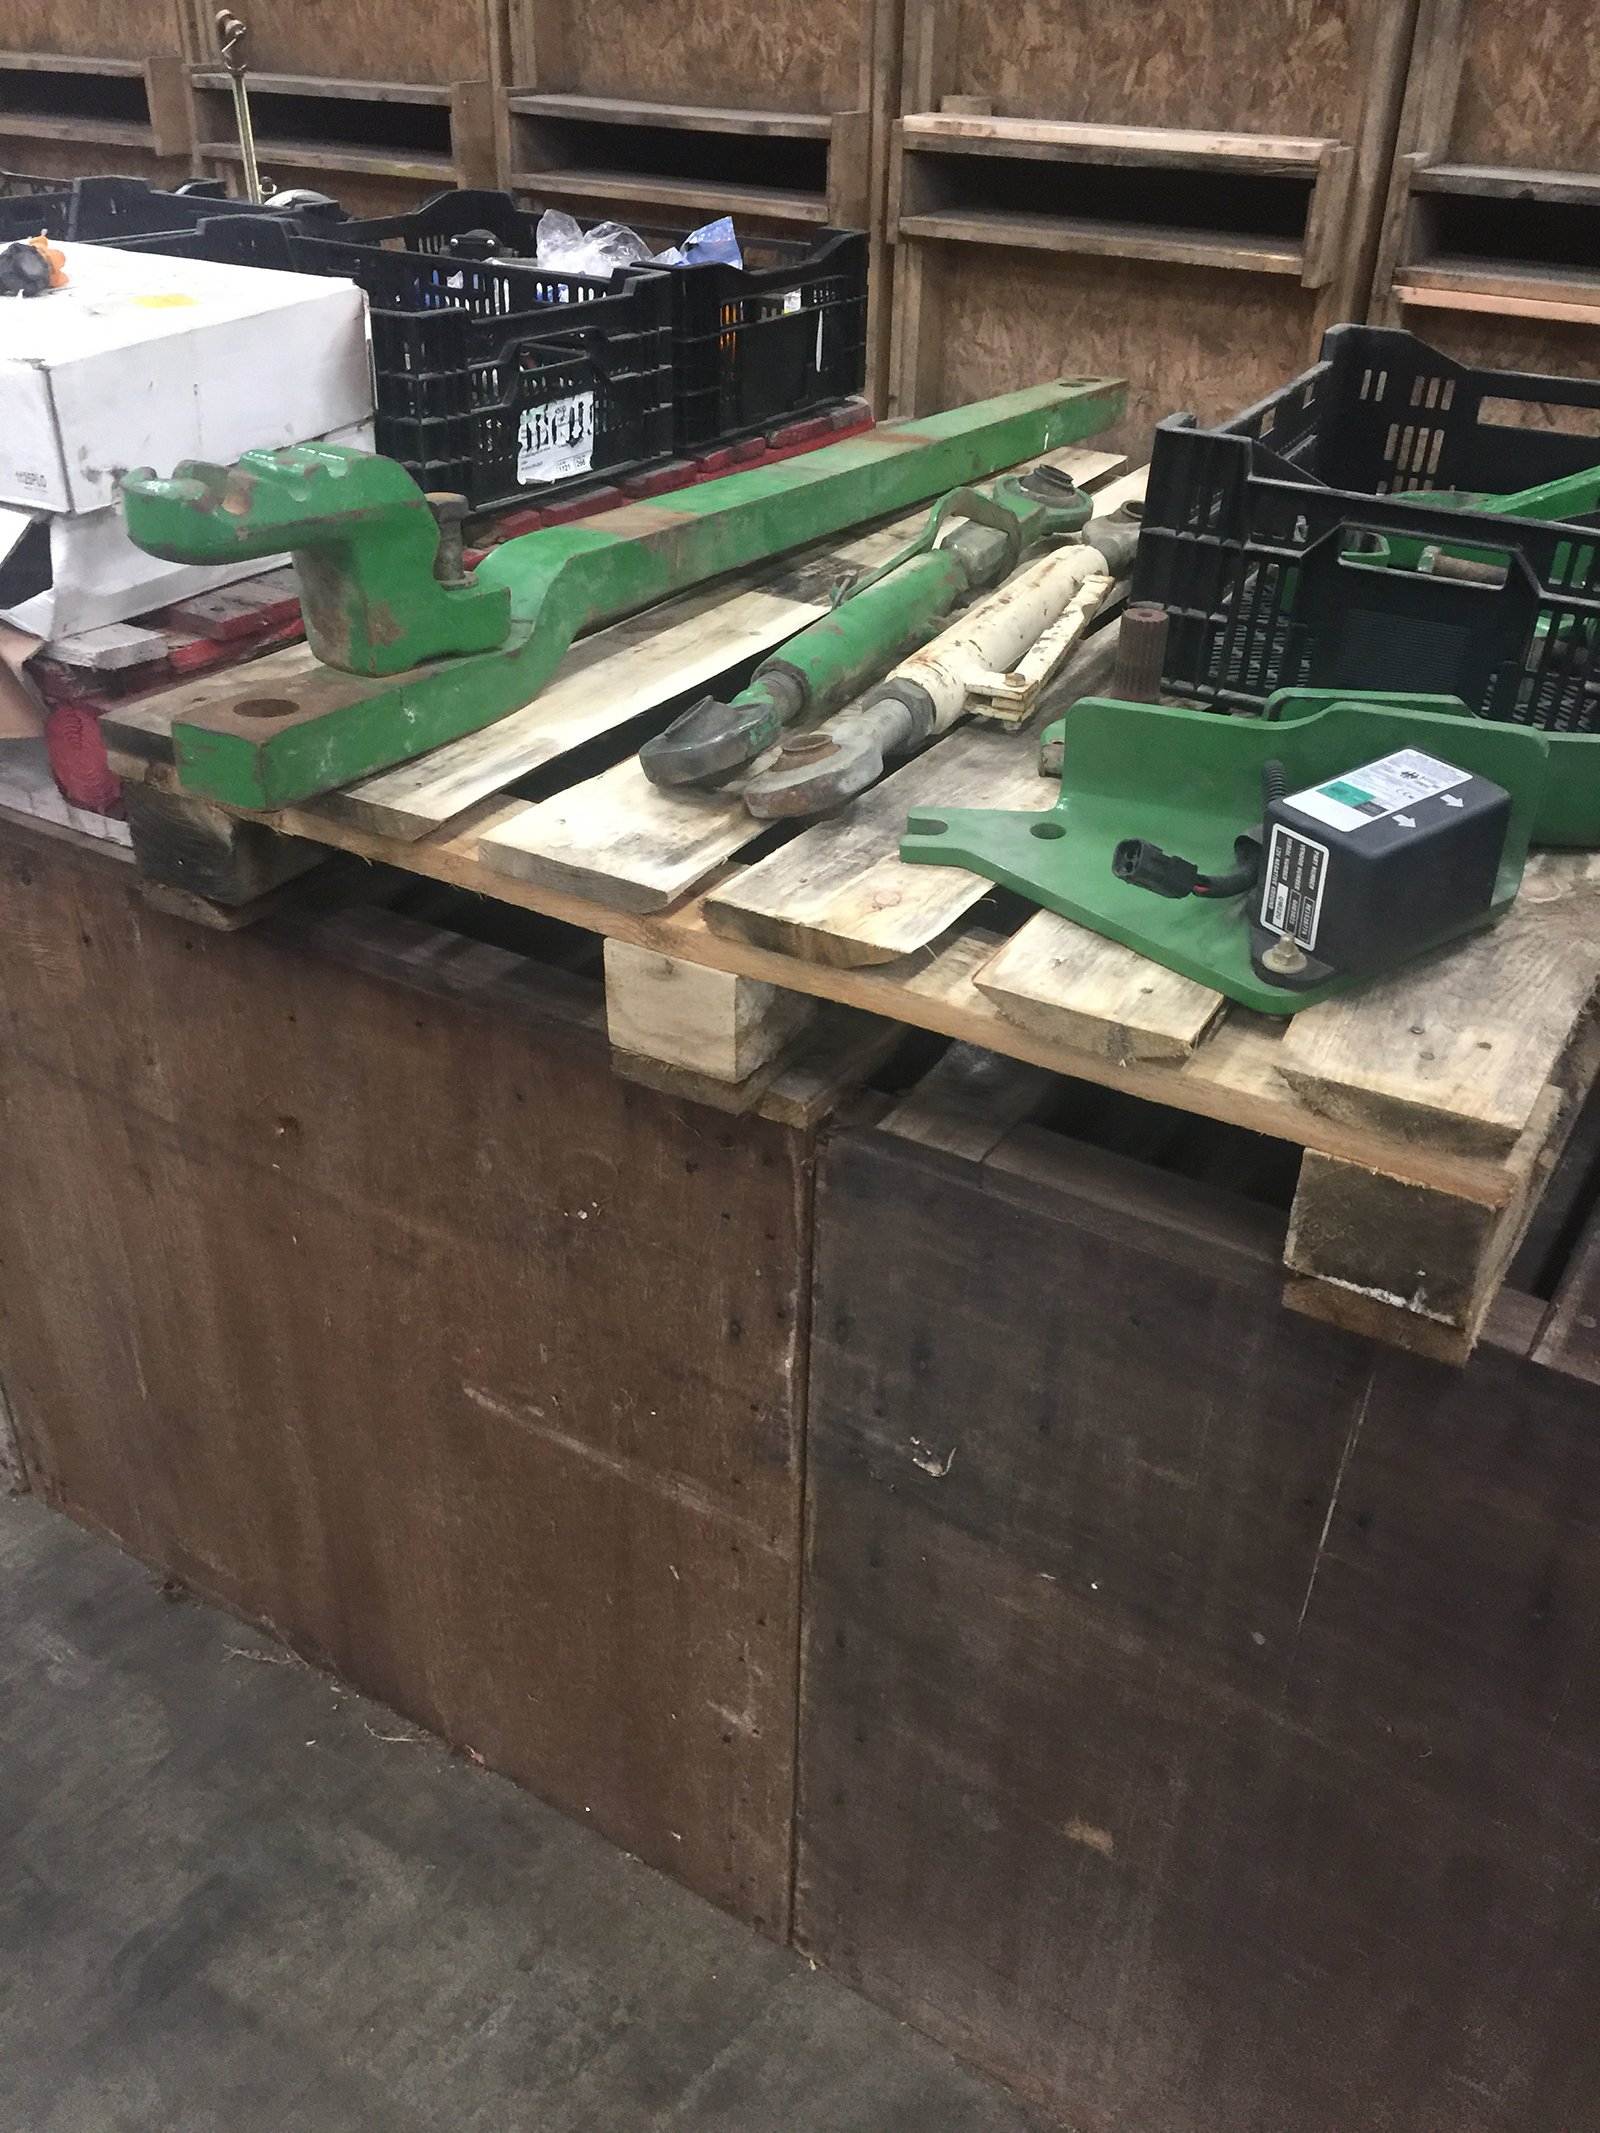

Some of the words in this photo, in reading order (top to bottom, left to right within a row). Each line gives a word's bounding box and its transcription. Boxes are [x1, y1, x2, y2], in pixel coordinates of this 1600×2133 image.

[1285, 837, 1293, 856] SERIAL
[1297, 844, 1306, 867] VENDOR
[1312, 850, 1320, 866] PART
[1272, 857, 1280, 886] NEGATIVE
[1282, 858, 1290, 881] NUMBER
[1294, 867, 1303, 890] NUMBER
[1308, 866, 1317, 890] NUMBER
[1268, 886, 1276, 910] GROUND
